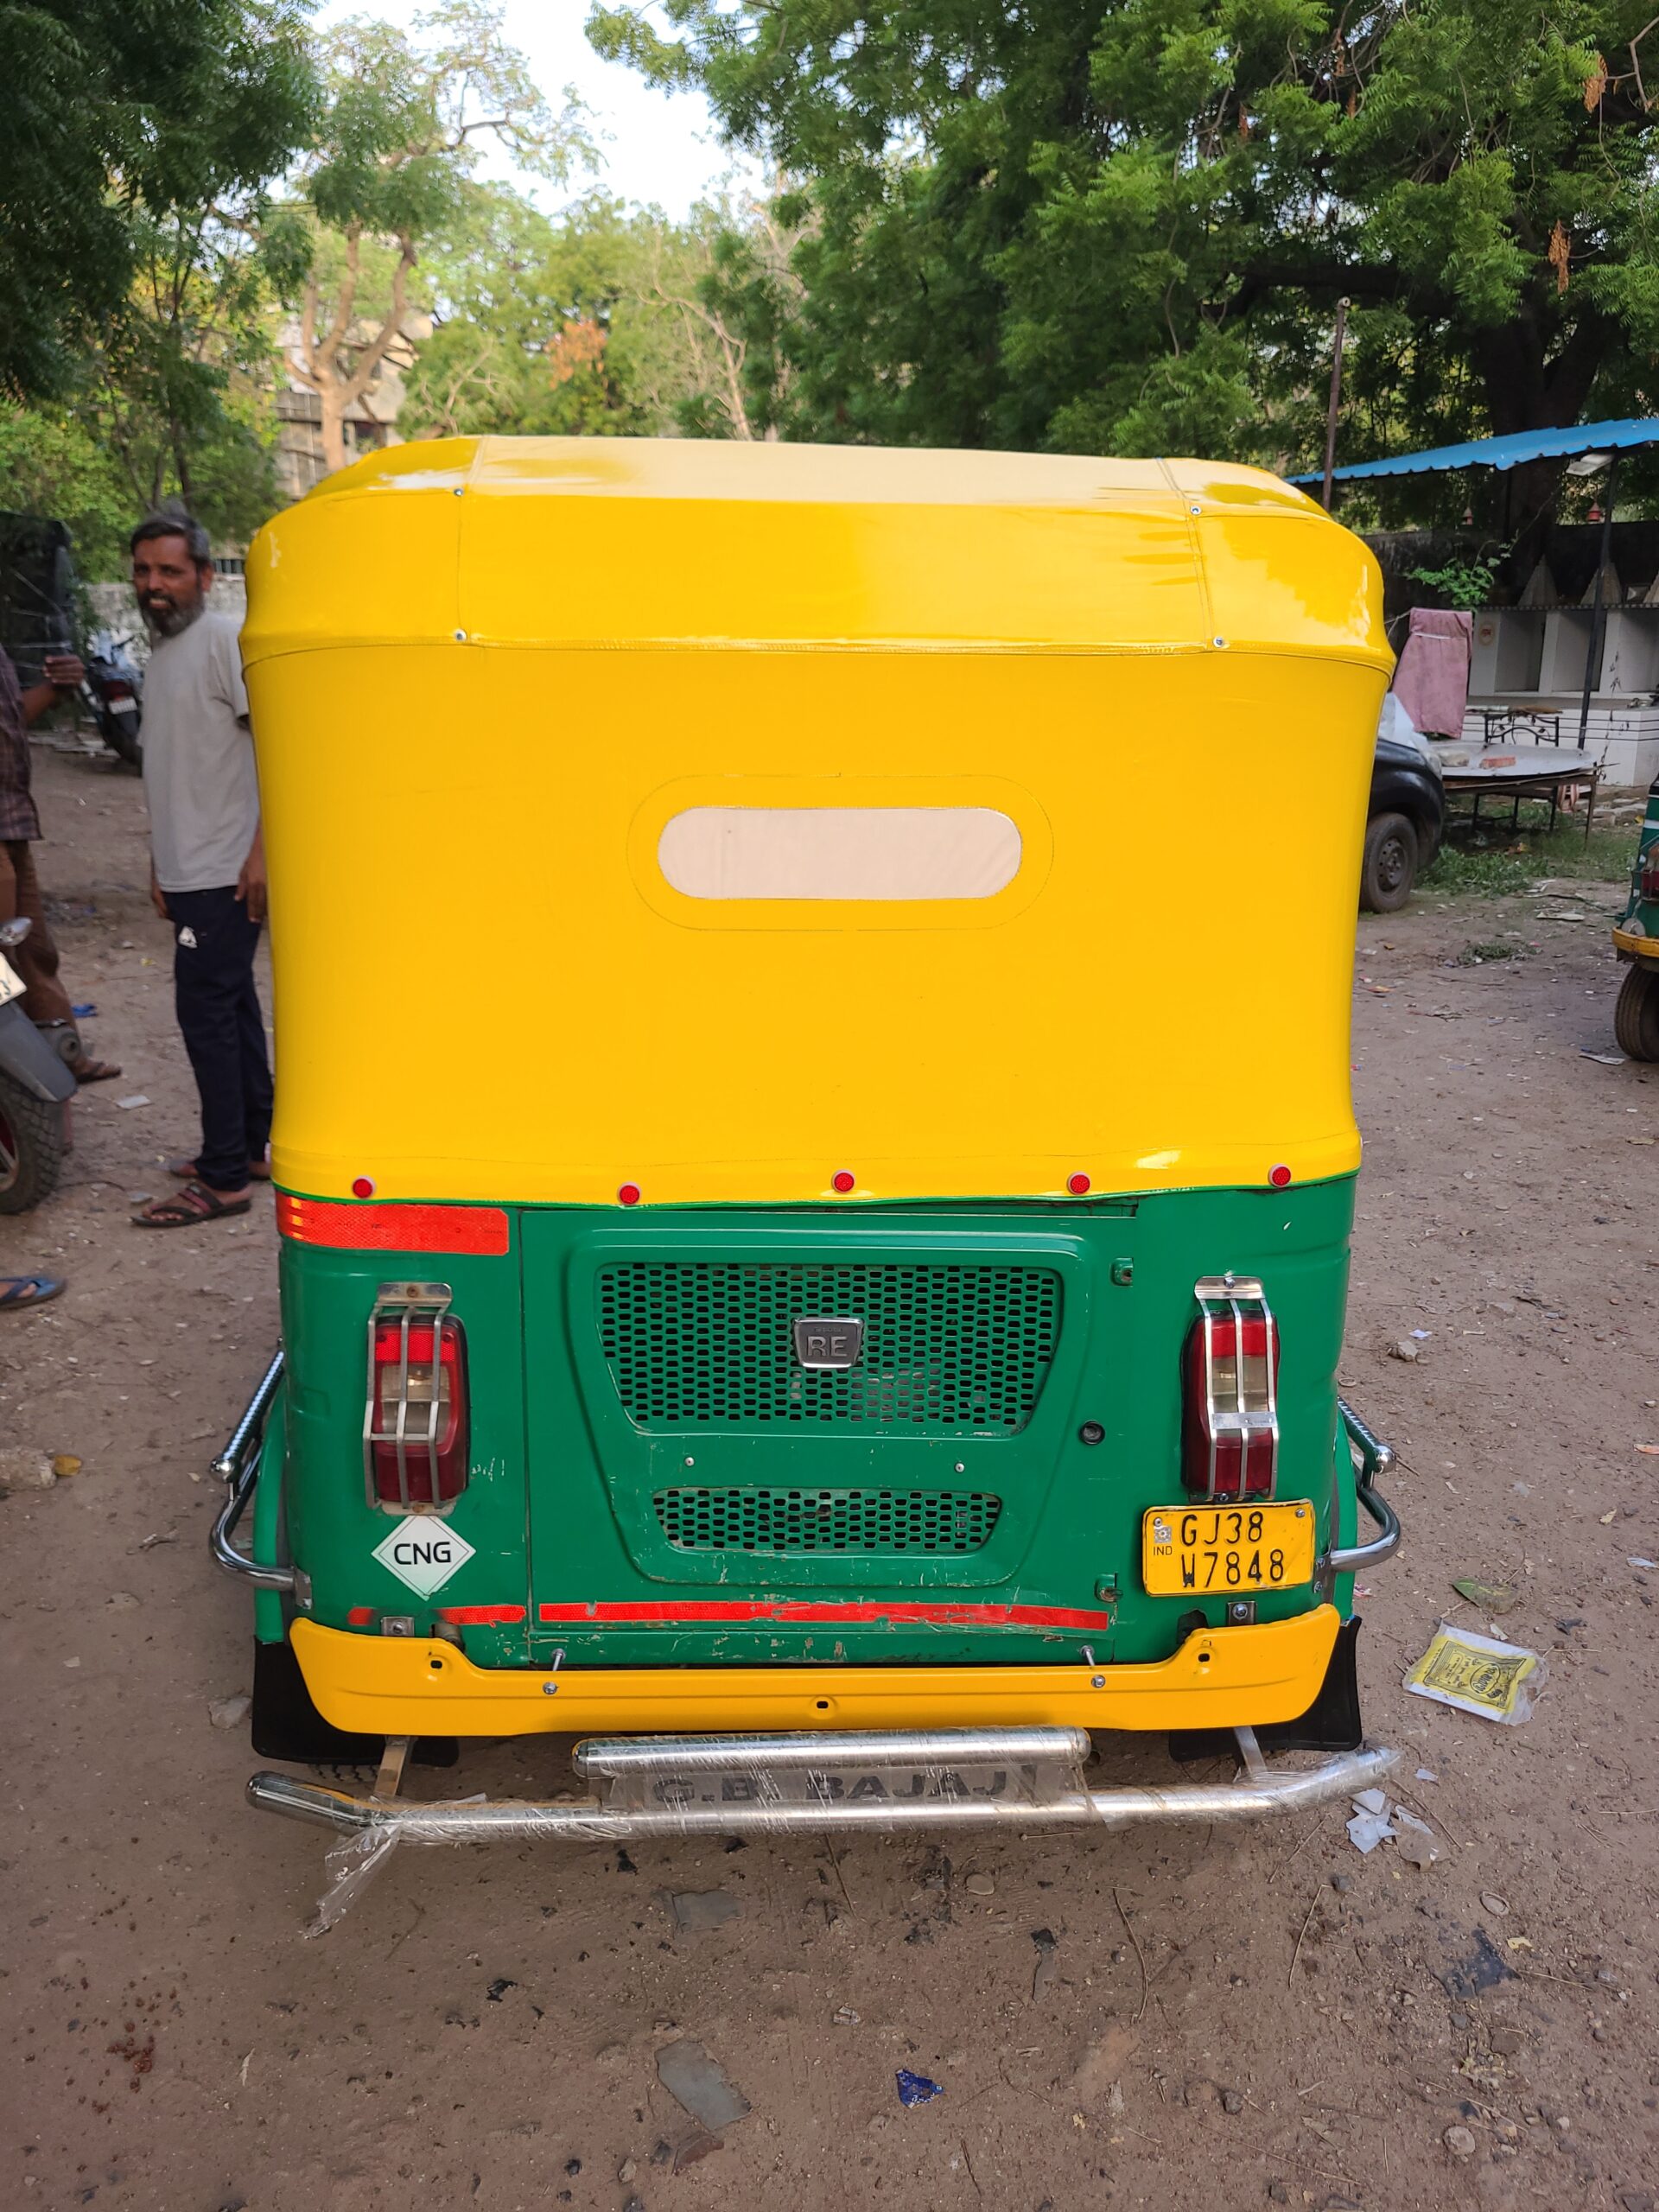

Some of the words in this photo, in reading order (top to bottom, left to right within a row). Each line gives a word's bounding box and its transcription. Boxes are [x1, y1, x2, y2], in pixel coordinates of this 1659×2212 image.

[806, 1336, 848, 1357] RE
[1180, 1510, 1264, 1547] GJ38
[394, 1541, 451, 1565] CNG
[1153, 1545, 1173, 1555] IND
[1180, 1548, 1284, 1588] W7848
[805, 1771, 1007, 1800] BAJAJ
